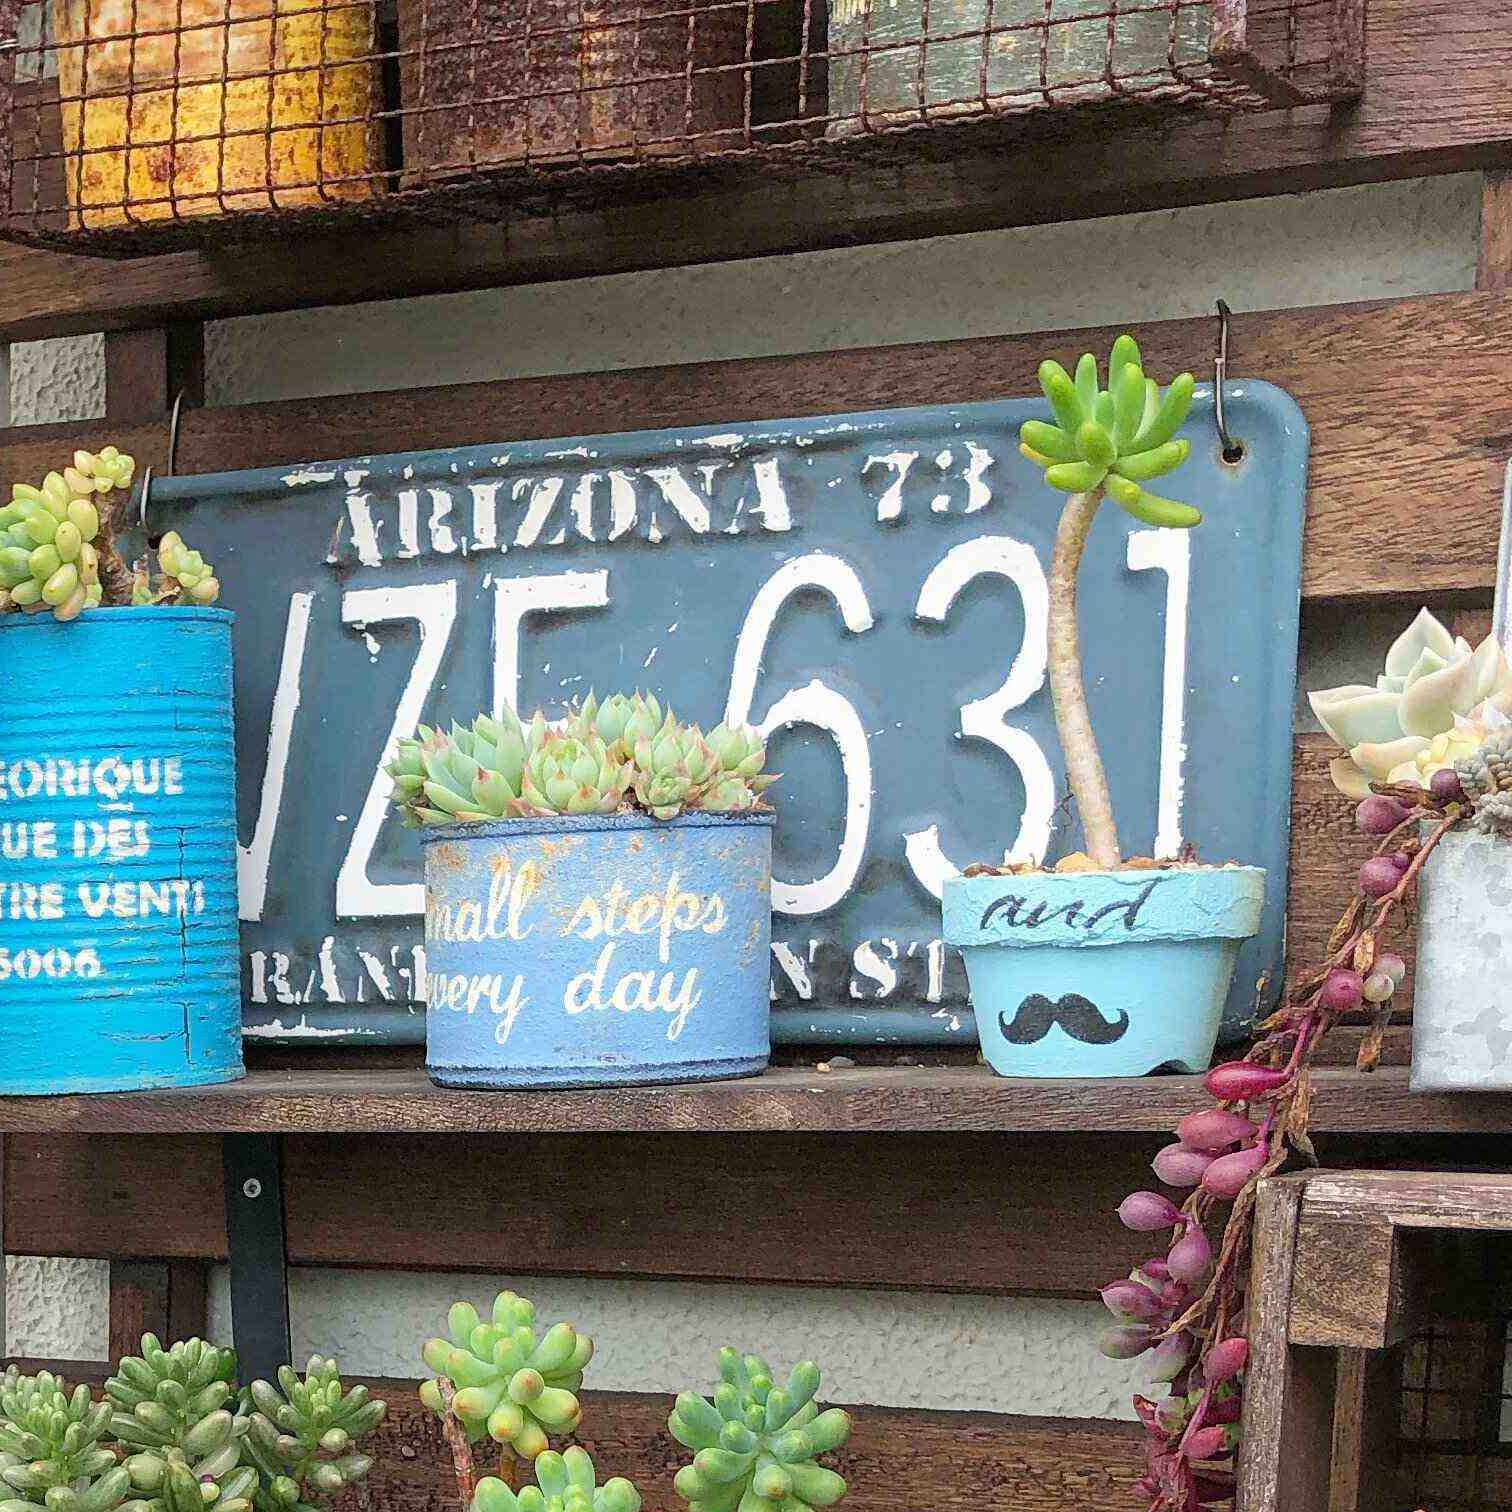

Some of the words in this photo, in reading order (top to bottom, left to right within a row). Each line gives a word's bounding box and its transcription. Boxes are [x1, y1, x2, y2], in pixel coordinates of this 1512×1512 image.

[327, 457, 791, 567] ARIZONA
[861, 441, 995, 522] 73
[726, 526, 1193, 915] 631
[72, 818, 151, 858] DES
[559, 870, 729, 964] steps
[979, 876, 1163, 931] and
[426, 970, 530, 1045] very
[563, 940, 703, 1041] day
[849, 937, 946, 1003] ST
